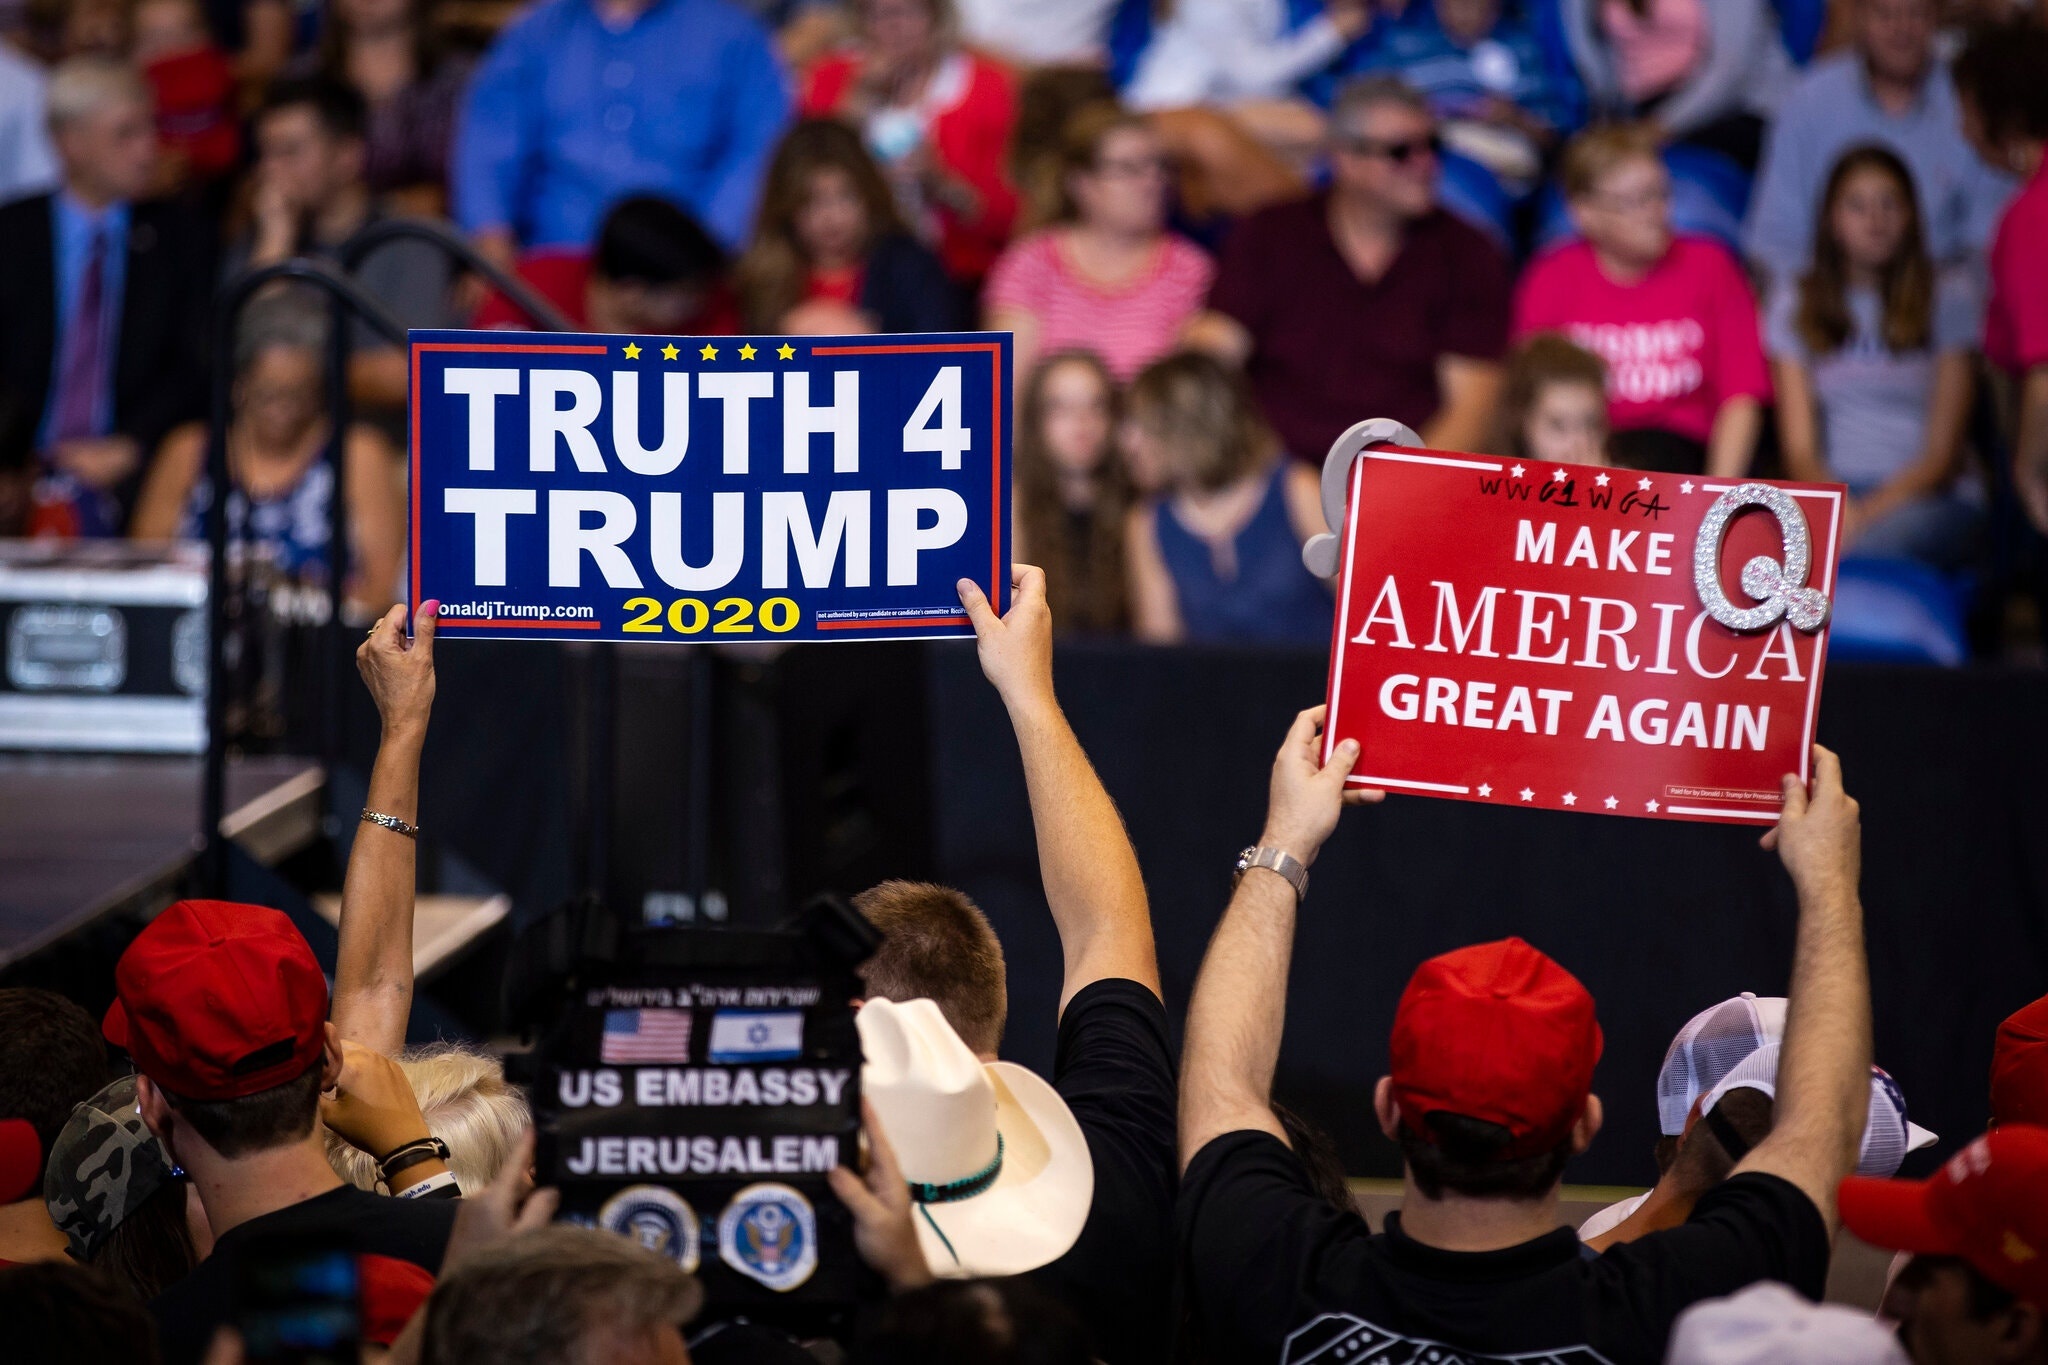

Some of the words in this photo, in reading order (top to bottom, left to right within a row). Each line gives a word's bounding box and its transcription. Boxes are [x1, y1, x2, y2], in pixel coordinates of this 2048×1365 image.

[444, 367, 859, 476] TRUTH
[903, 366, 971, 470] 4
[444, 488, 968, 592] TRUMP
[1515, 519, 1675, 576] MAKE
[1694, 483, 1832, 631] Q
[438, 601, 594, 620] onaldjTrump.com
[622, 597, 801, 634] 2020
[853, 611, 859, 619] by
[1351, 575, 1806, 682] AMERICA
[1378, 674, 1574, 736] GREAT
[1584, 695, 1771, 751] AGAIN
[1670, 787, 1684, 796] Paid
[1692, 789, 1700, 797] by
[1700, 789, 1720, 798] Donald
[1726, 791, 1743, 800] Trump
[559, 1068, 623, 1107] US
[635, 1067, 848, 1105] EMBASSY
[567, 1136, 839, 1174] JERUSALEM
